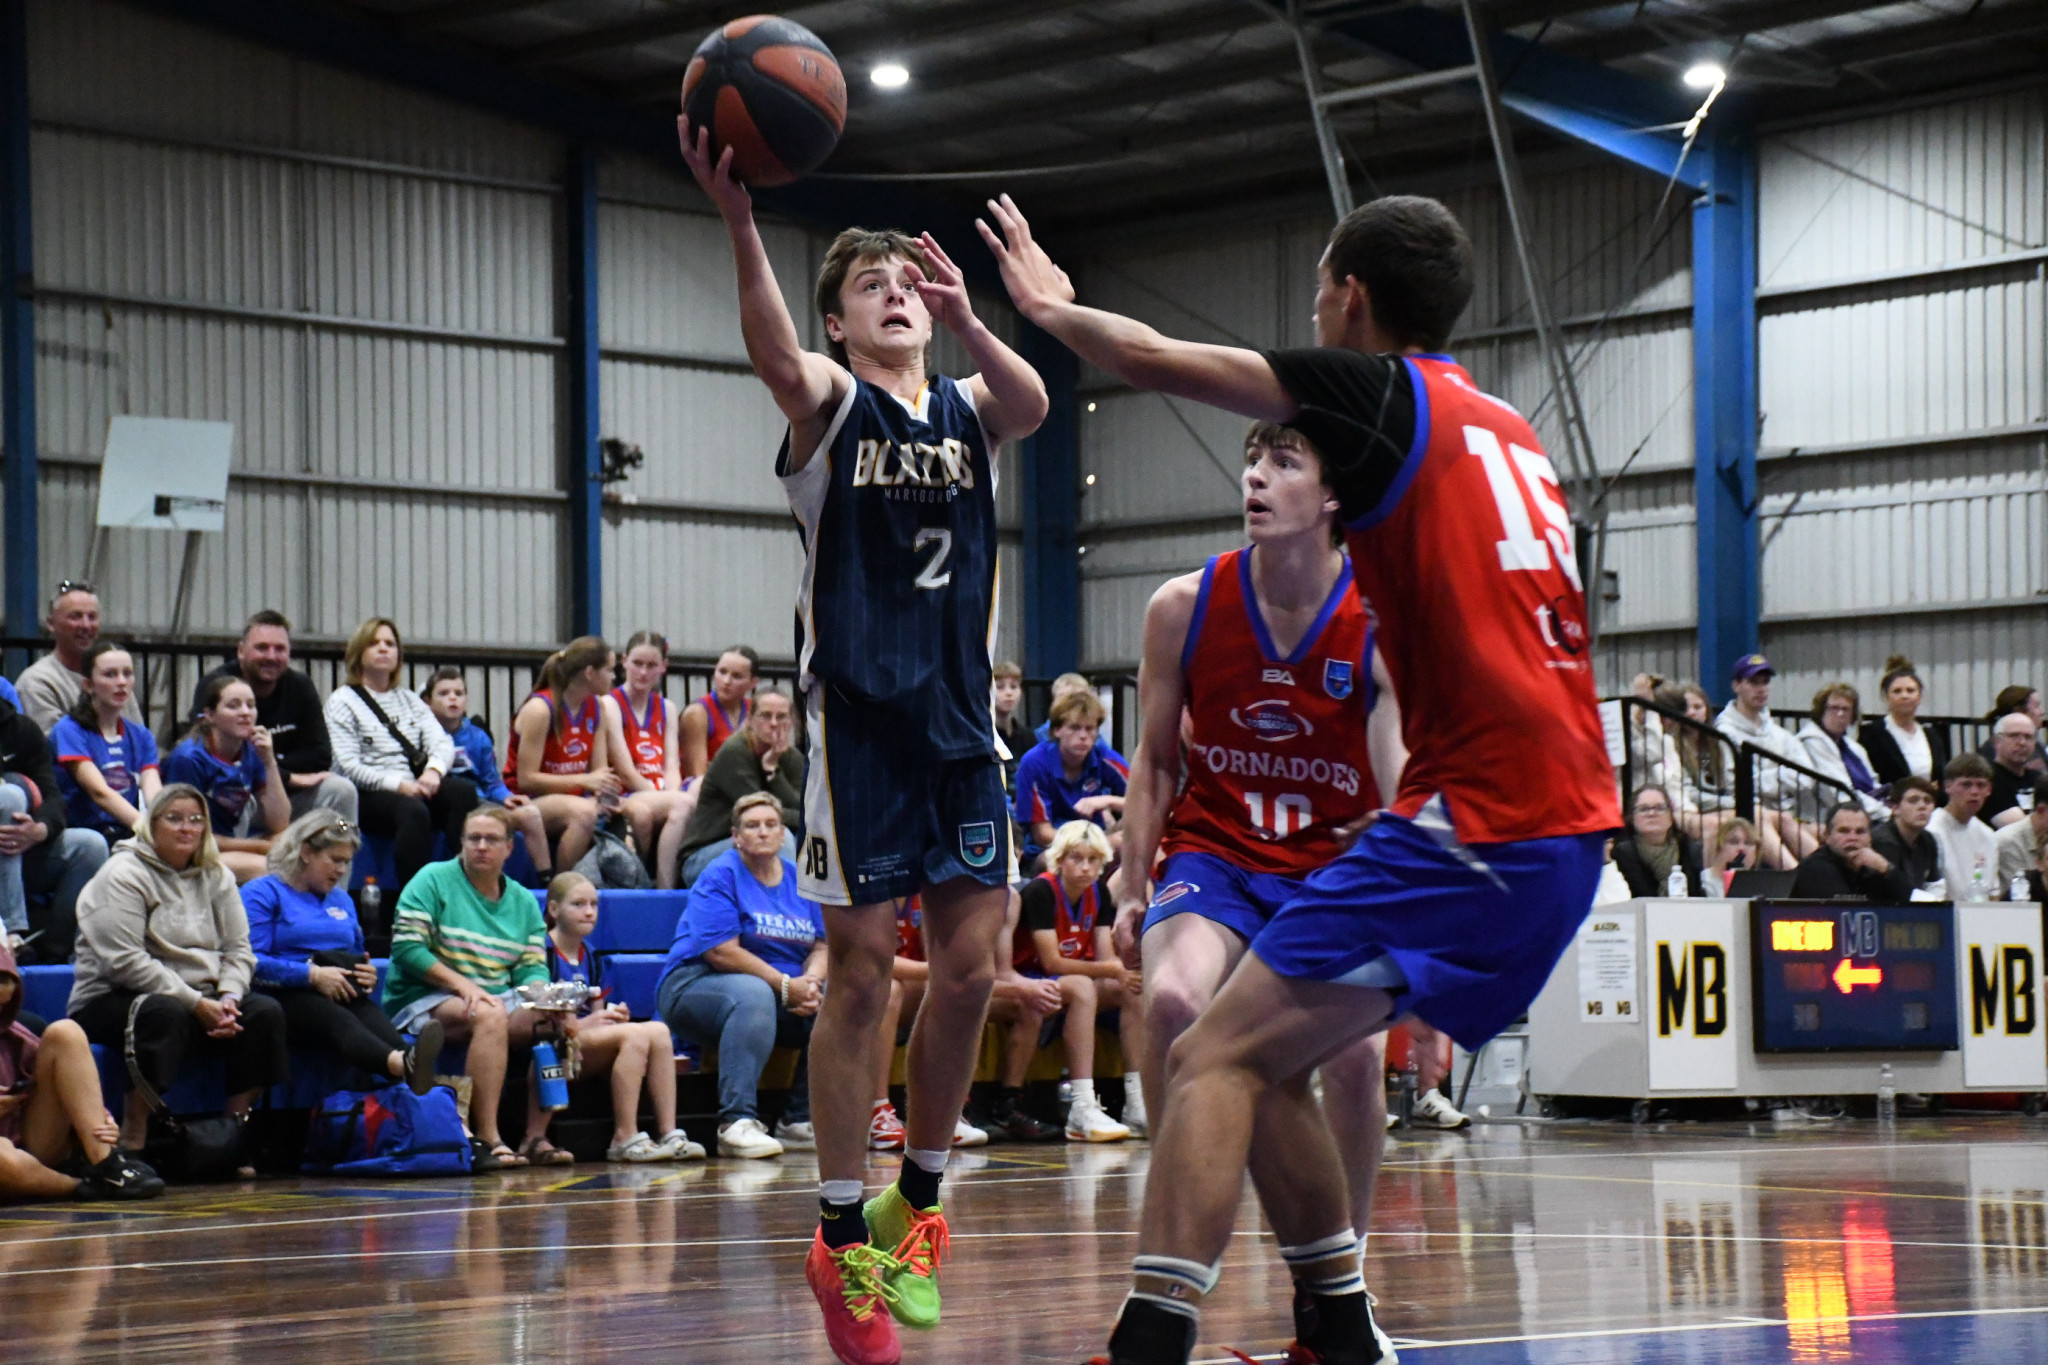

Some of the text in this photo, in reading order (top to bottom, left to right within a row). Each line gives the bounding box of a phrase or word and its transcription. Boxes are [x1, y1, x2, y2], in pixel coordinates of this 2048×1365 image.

[852, 437, 974, 490] BLAZRS
[1462, 424, 1584, 593] 15
[913, 526, 953, 591] 2
[1244, 791, 1313, 841] 10
[752, 912, 816, 934] TERANG
[1840, 911, 1880, 957] MB
[1655, 940, 1727, 1039] MB
[1967, 942, 2037, 1038] MB
[541, 1067, 565, 1078] YET
